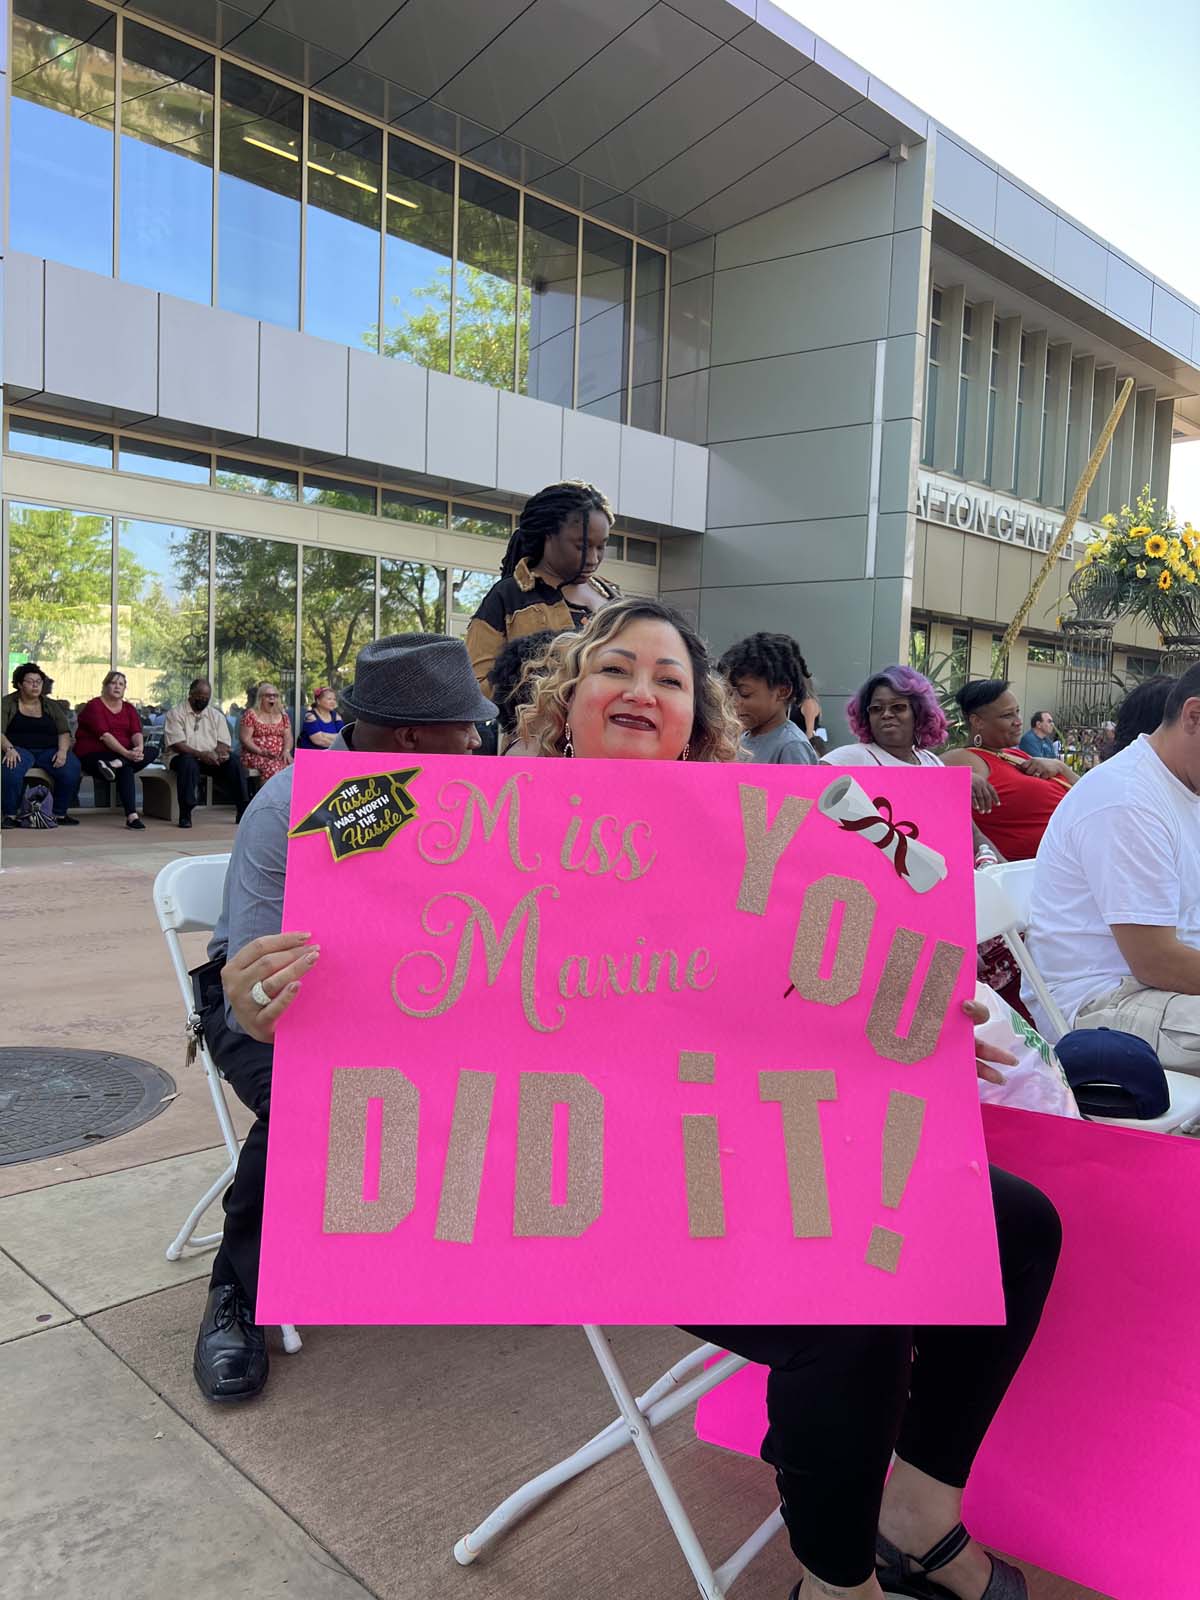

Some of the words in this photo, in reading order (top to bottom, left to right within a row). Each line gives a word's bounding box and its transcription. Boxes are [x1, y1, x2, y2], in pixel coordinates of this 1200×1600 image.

[328, 779, 381, 817] Tassel
[334, 812, 356, 829] WAS
[355, 794, 390, 817] WORTH
[340, 784, 360, 800] THE
[342, 808, 402, 849] Hassle
[358, 813, 378, 828] THE
[418, 771, 658, 881] Miss
[736, 783, 965, 1066] YOU
[391, 884, 719, 1034] Maxine
[323, 1068, 606, 1246] DID
